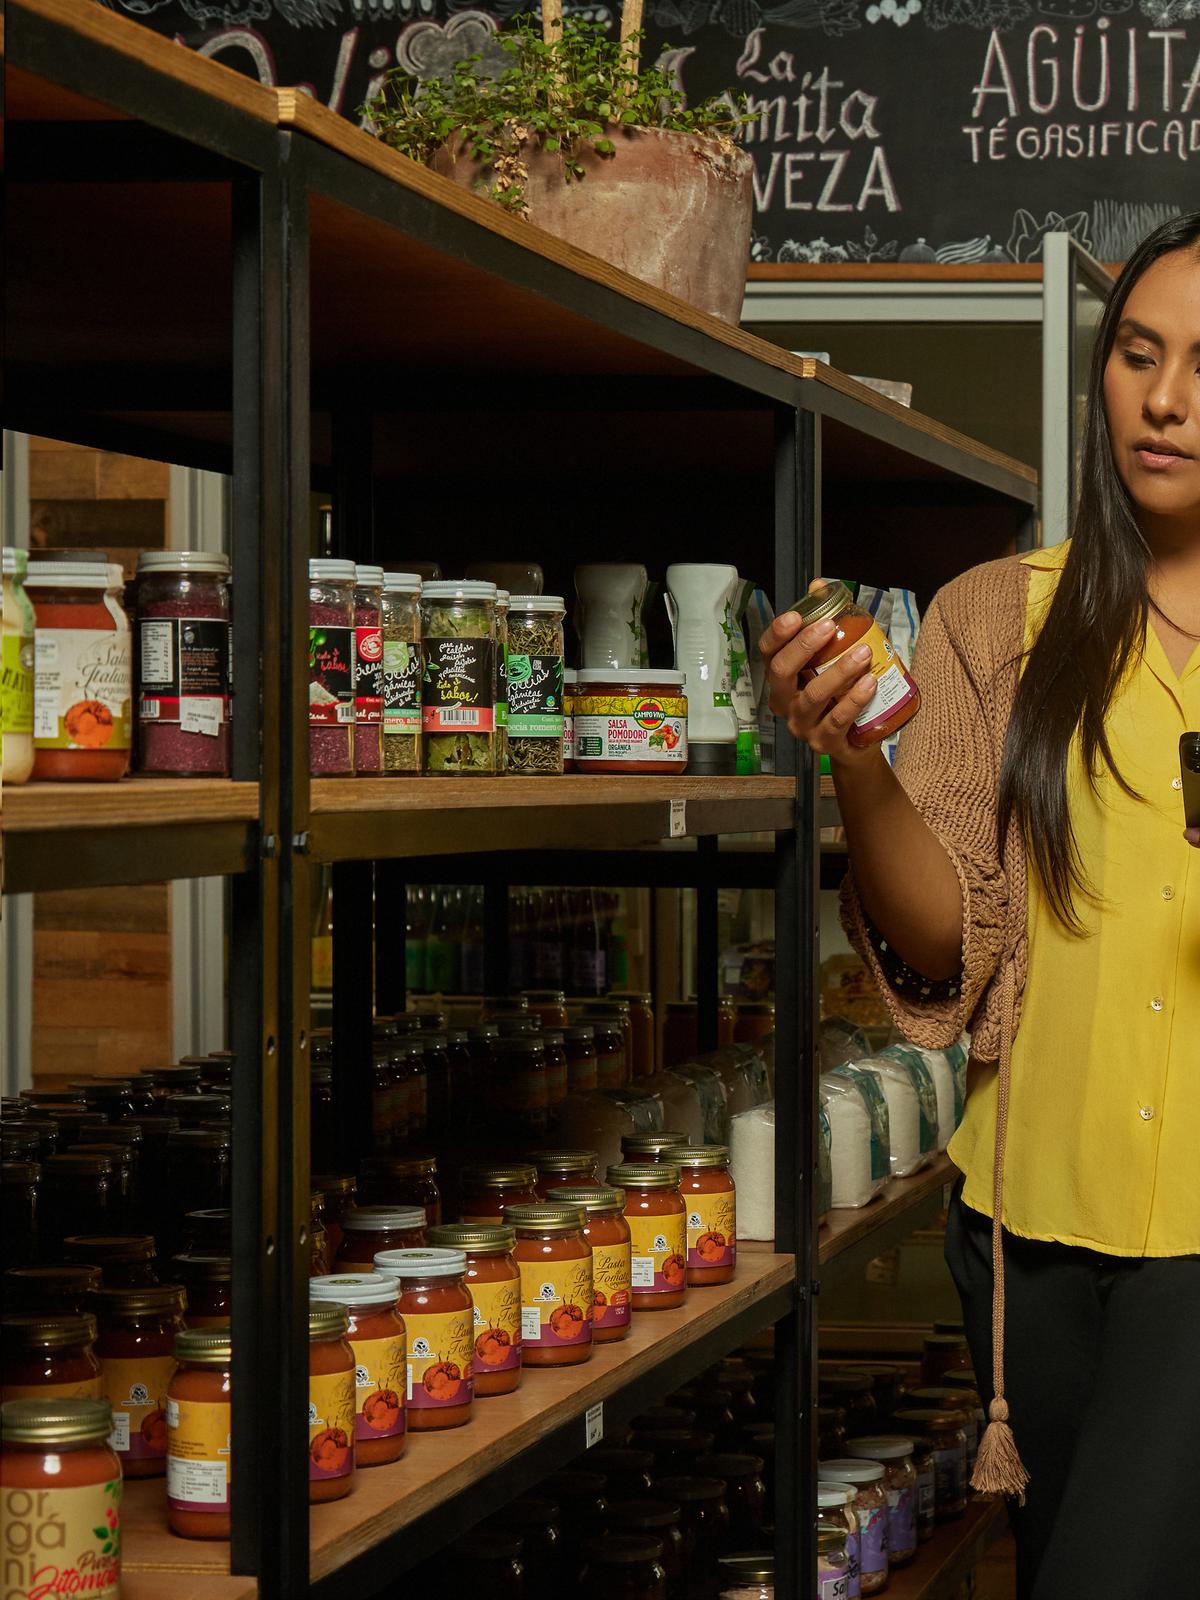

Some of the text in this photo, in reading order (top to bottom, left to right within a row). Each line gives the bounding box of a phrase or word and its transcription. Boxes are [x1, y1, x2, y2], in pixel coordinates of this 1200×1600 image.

[736, 27, 796, 83] La
[962, 119, 1006, 163] TÉ
[607, 729, 648, 740] POMODORO
[608, 719, 628, 729] SALSA
[607, 742, 632, 751] ORGÁNICA
[596, 1257, 625, 1269] Pasta
[6, 1490, 49, 1518] or
[6, 1512, 66, 1556] gá
[5, 1552, 37, 1587] ni
